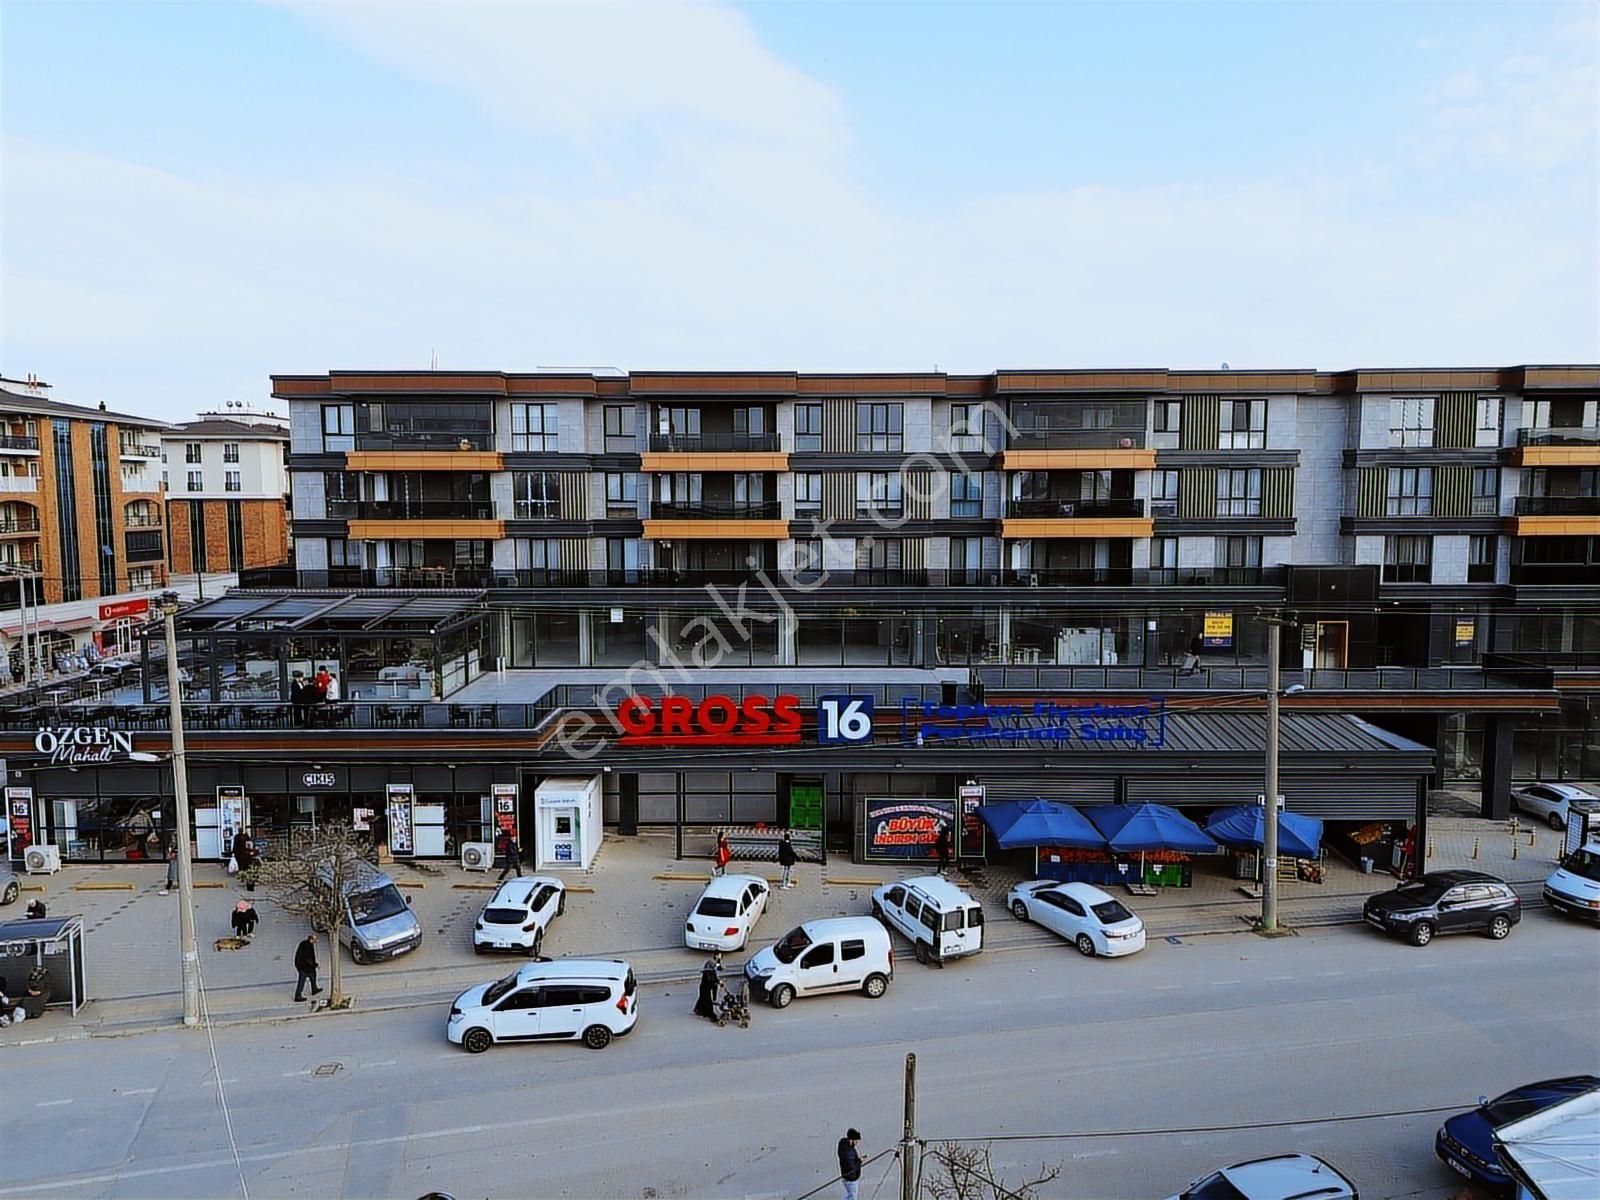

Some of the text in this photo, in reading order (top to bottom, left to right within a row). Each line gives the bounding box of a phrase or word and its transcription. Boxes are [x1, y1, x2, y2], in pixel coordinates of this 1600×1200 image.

[617, 694, 871, 740] GROSS 16
[35, 727, 134, 754] ÖZGEN
[51, 744, 113, 765] Mahall
[14, 804, 25, 814] 16
[499, 801, 510, 811] 16
[887, 816, 938, 833] BÜYÜK
